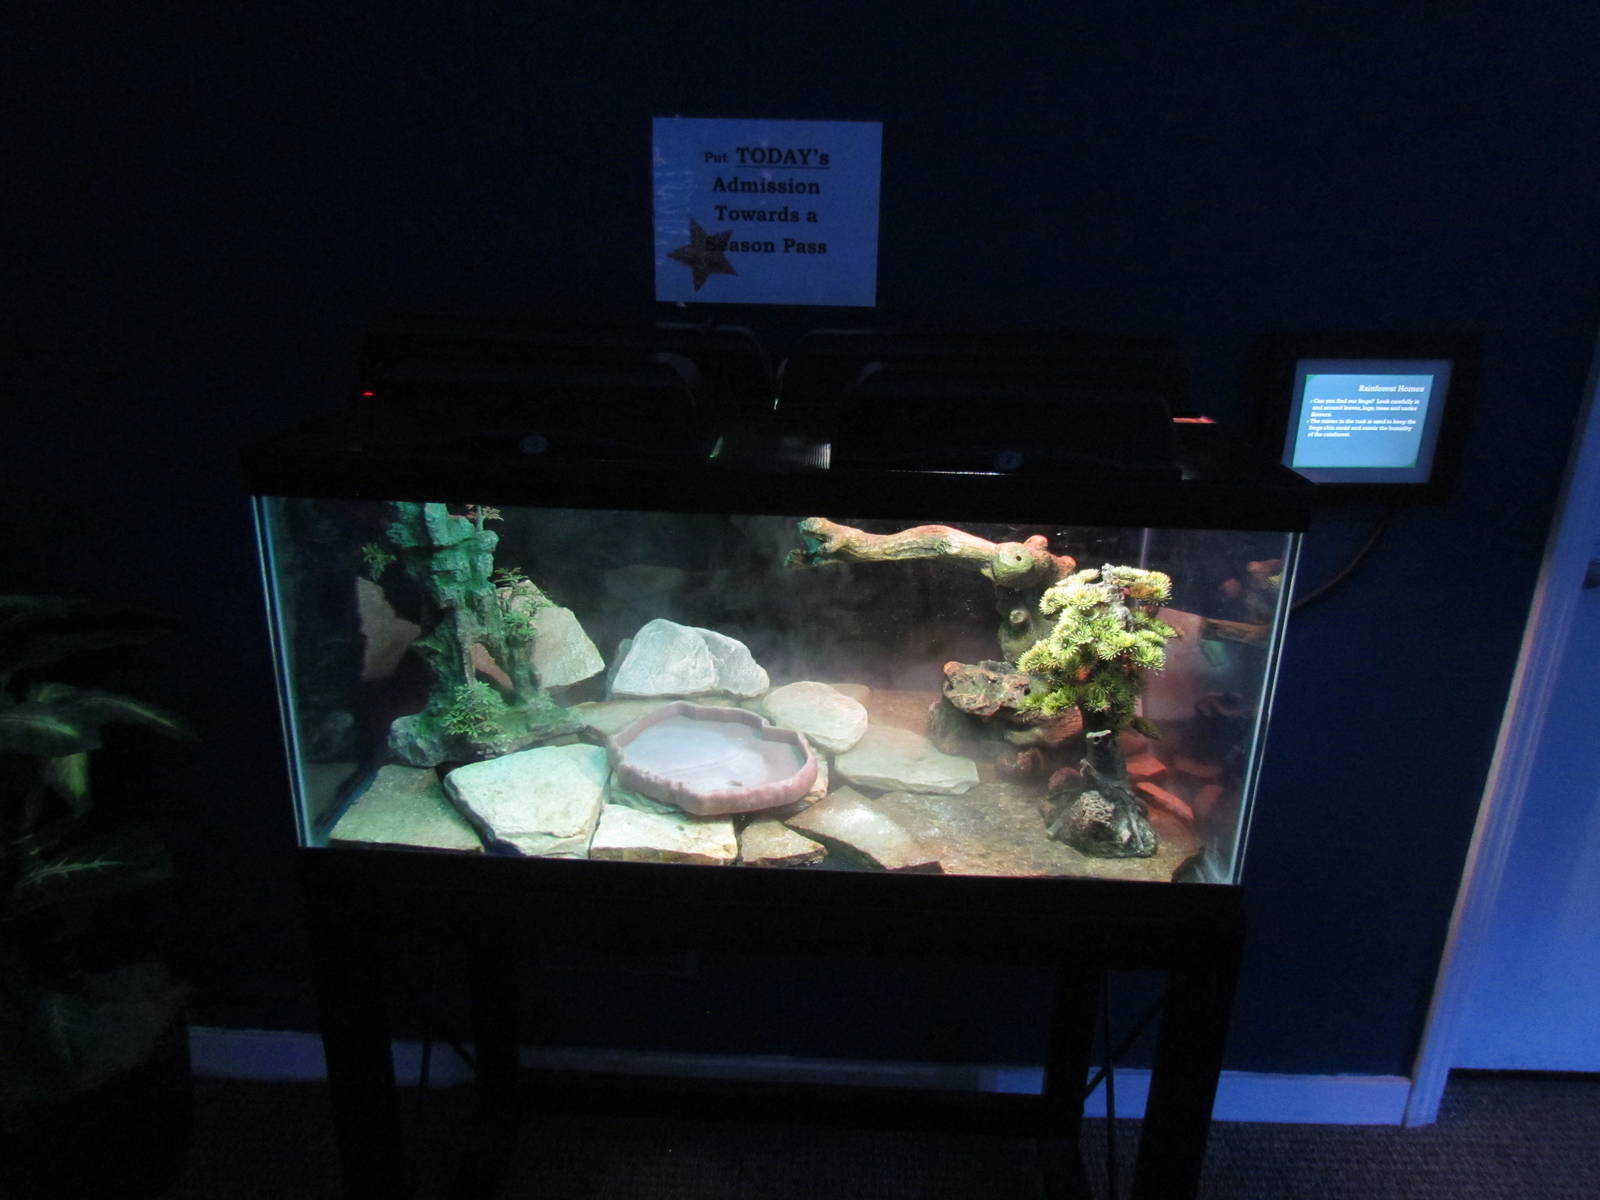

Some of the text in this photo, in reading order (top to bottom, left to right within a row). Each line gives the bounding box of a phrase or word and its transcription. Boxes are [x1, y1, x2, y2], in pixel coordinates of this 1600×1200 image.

[704, 147, 830, 166] Put TODAY's
[712, 176, 821, 195] Admission
[714, 205, 818, 223] Towards a
[705, 236, 828, 254] Season Pass
[1359, 384, 1397, 393] Rainfot
